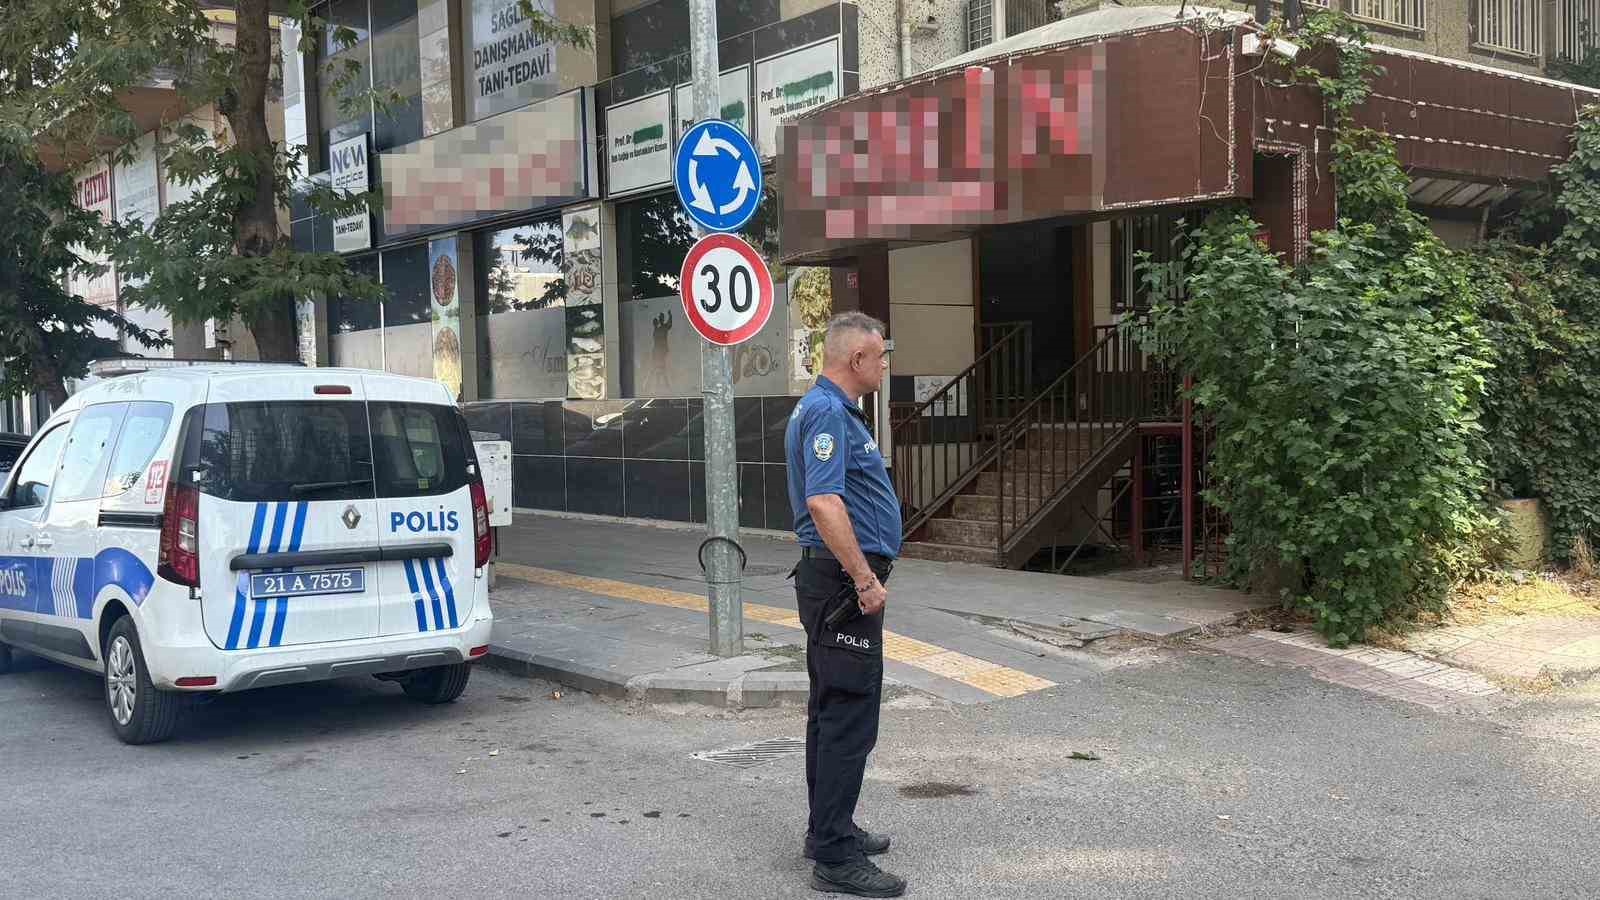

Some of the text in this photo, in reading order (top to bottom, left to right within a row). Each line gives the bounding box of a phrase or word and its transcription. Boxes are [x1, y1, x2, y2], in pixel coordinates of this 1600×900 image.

[479, 48, 550, 97] TANI-TEDAVİ
[701, 265, 753, 313] 30
[391, 505, 459, 532] POLİS
[264, 573, 352, 593] 21 A 7575
